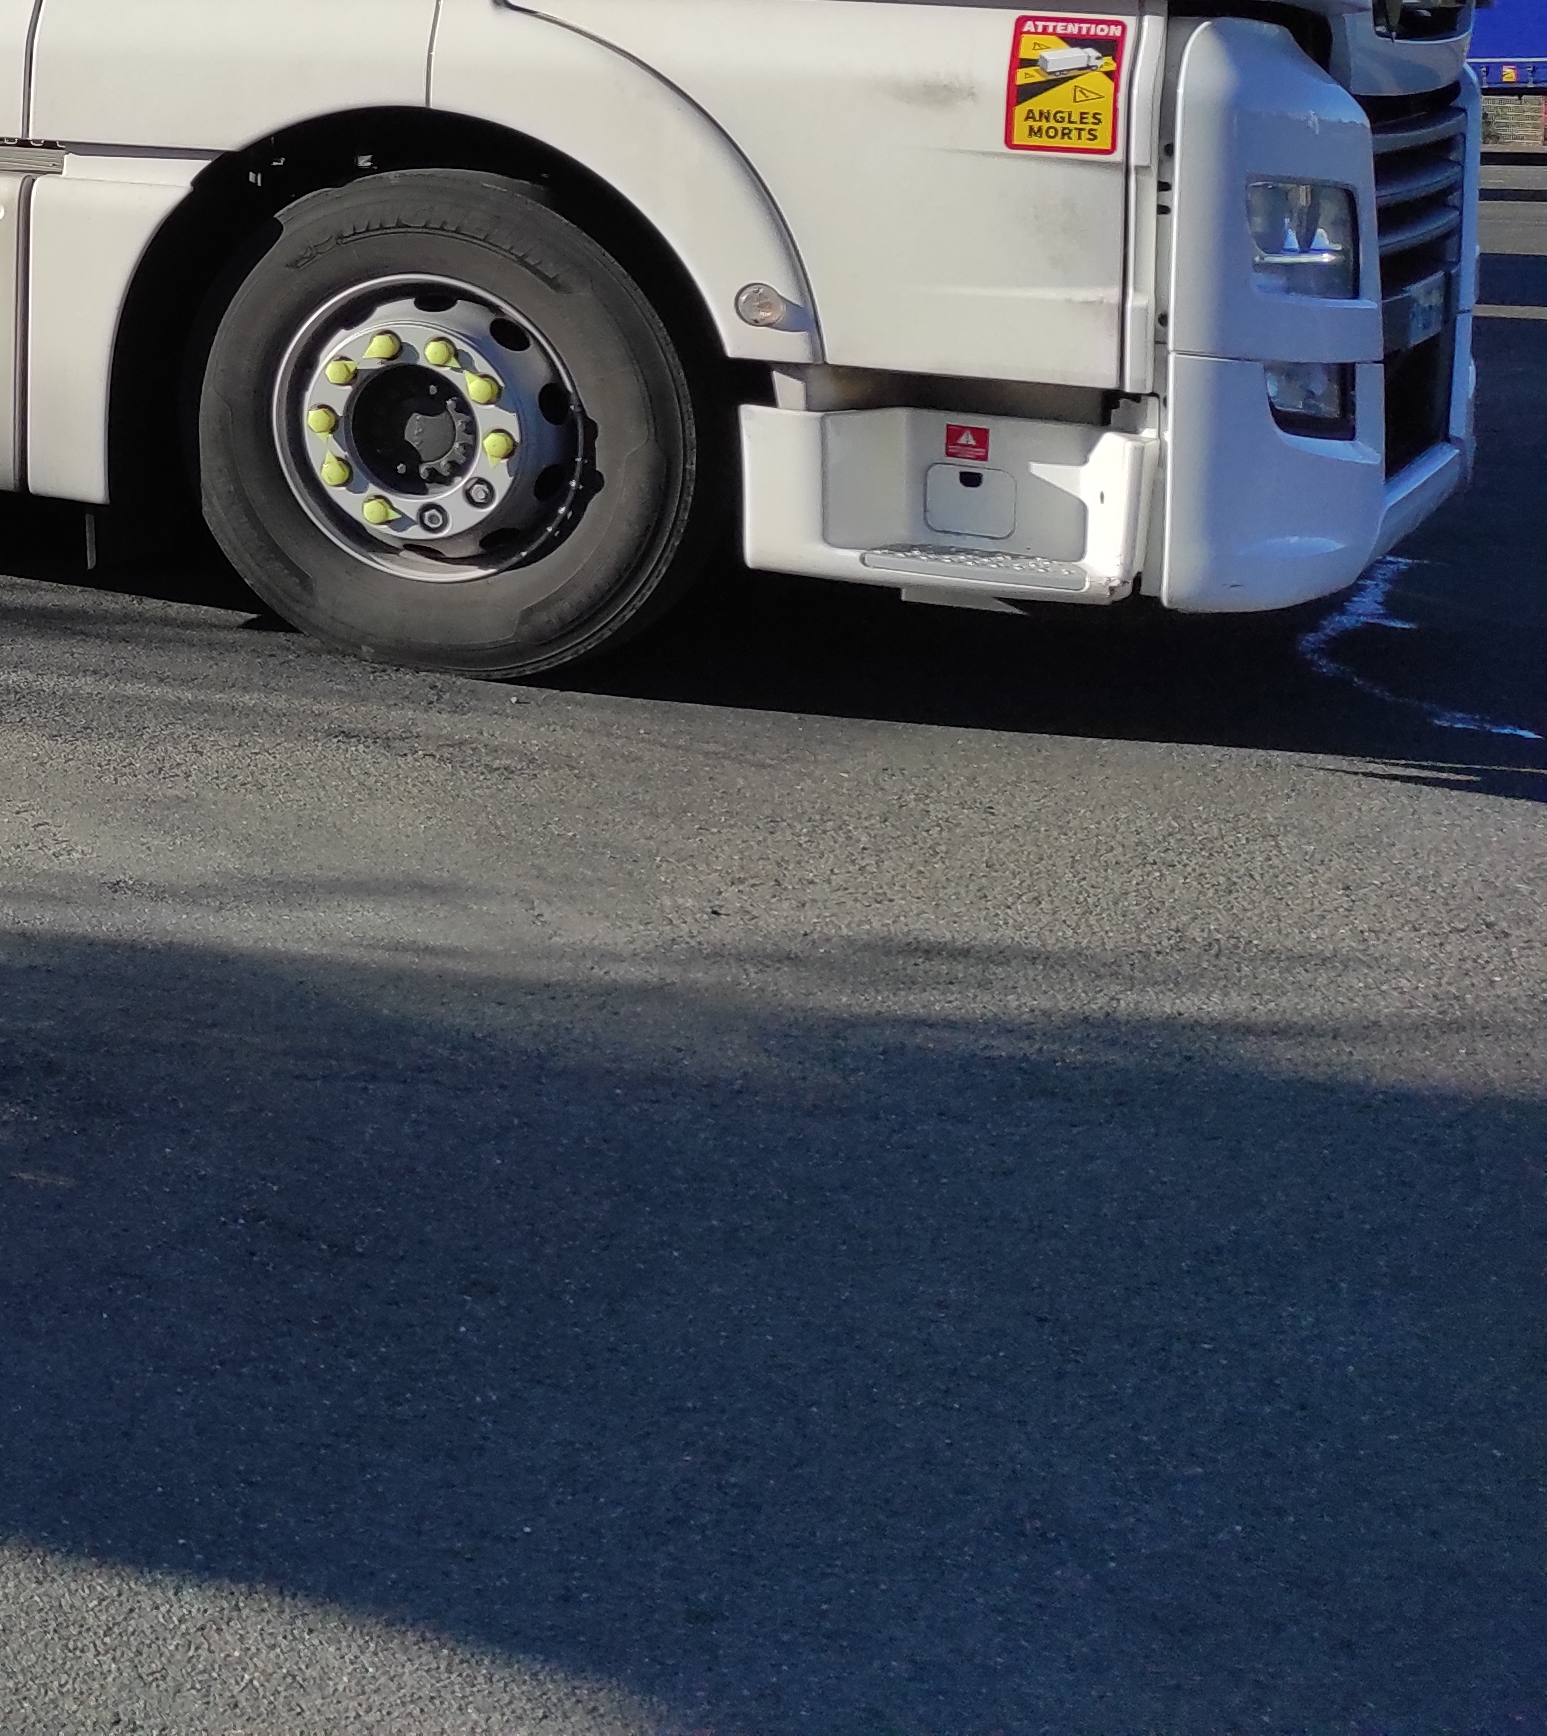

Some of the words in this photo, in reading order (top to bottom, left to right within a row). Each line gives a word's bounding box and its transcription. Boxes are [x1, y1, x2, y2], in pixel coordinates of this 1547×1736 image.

[1022, 20, 1123, 37] ATTENTION
[1023, 108, 1103, 126] ANGLES
[1027, 124, 1099, 142] MORTS
